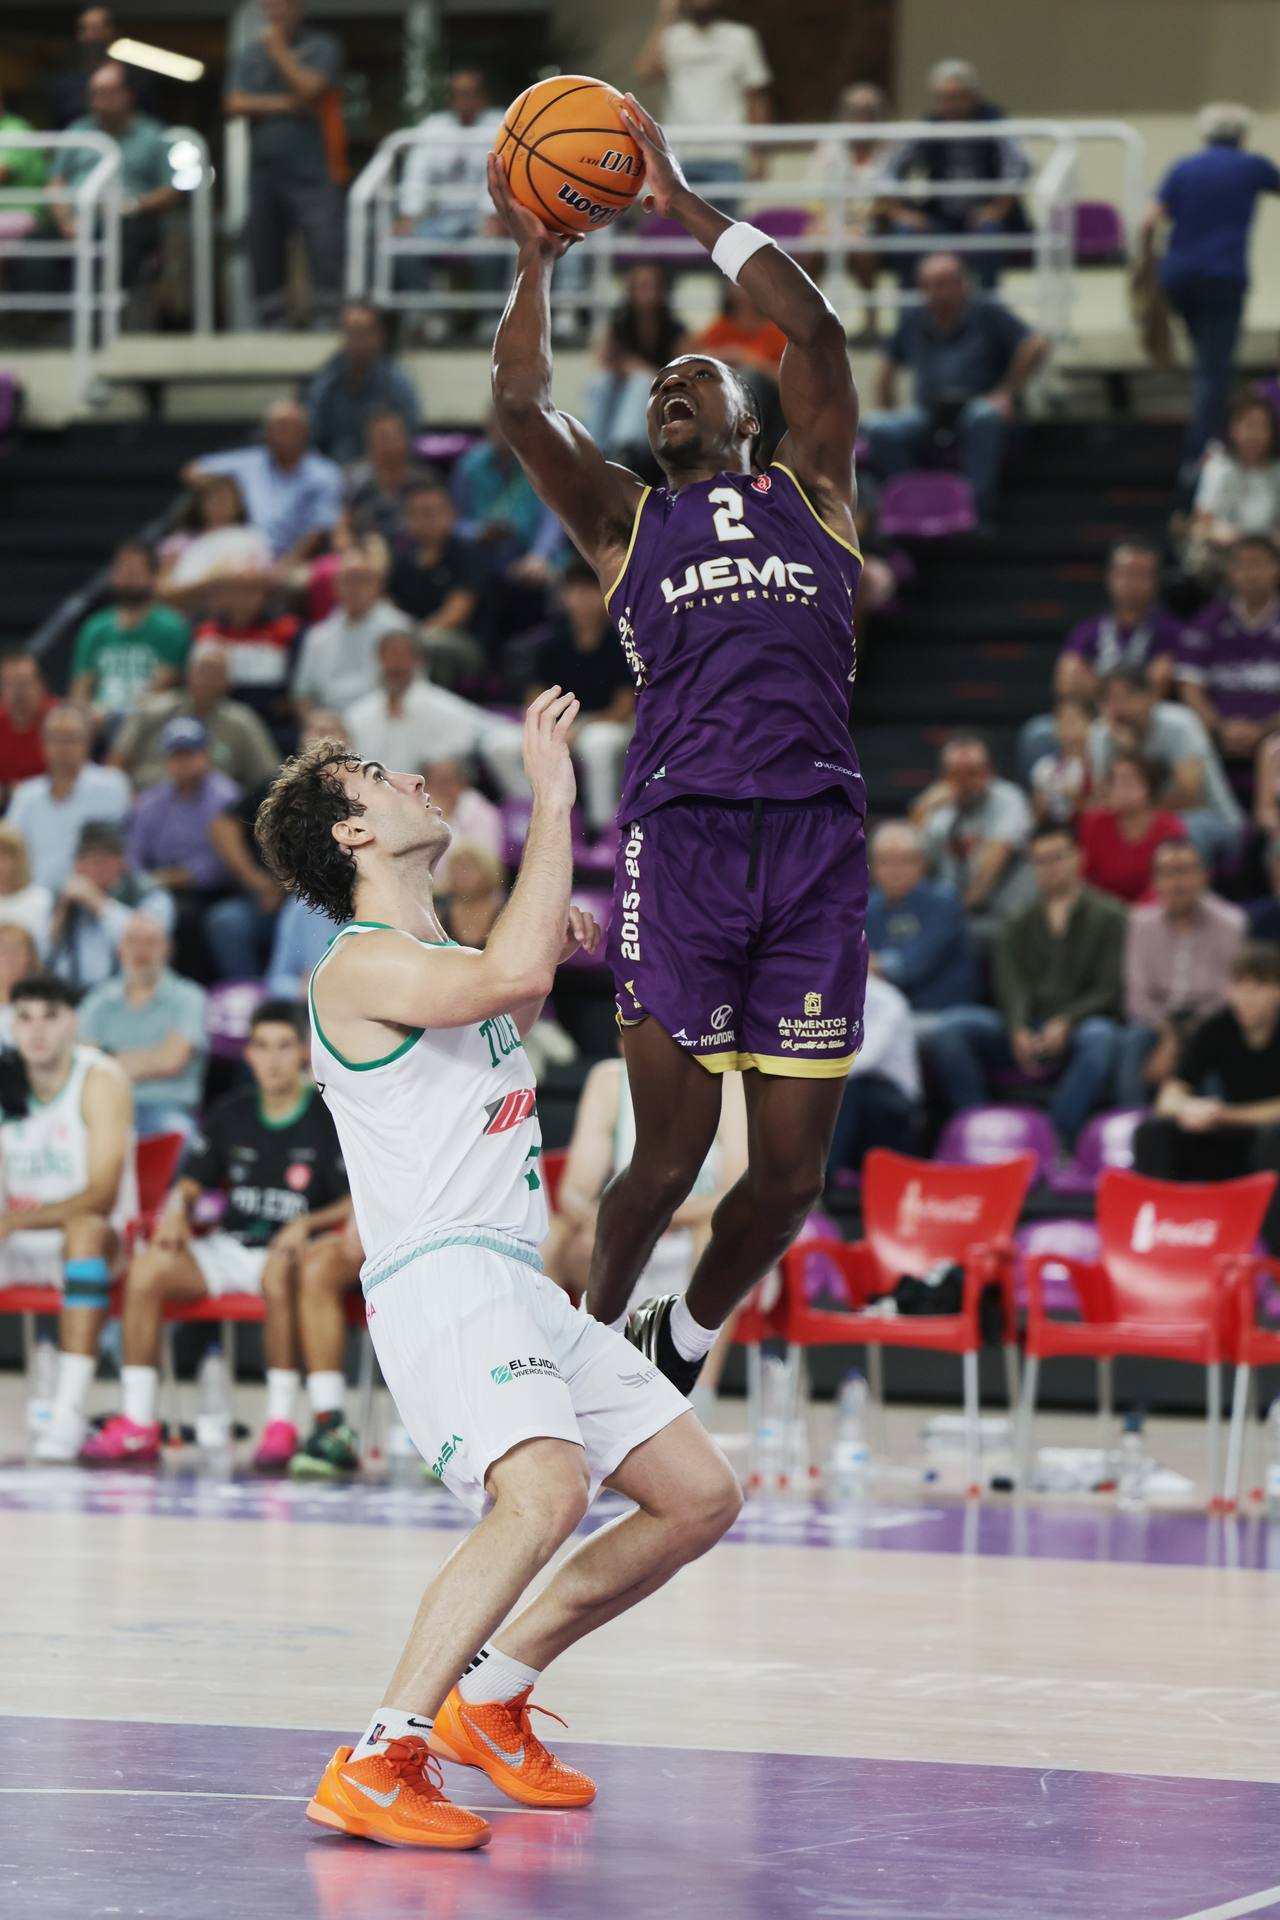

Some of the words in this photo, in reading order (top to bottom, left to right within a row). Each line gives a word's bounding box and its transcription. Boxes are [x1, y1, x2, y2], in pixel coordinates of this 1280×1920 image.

[557, 183, 618, 223] lson
[708, 488, 754, 541] 2
[660, 556, 818, 603] UEMC
[778, 1017, 847, 1028] ALIMENTOS
[793, 1028, 847, 1037] VALLADOLID
[509, 1359, 526, 1371] EL
[514, 1368, 543, 1378] VIVEROS
